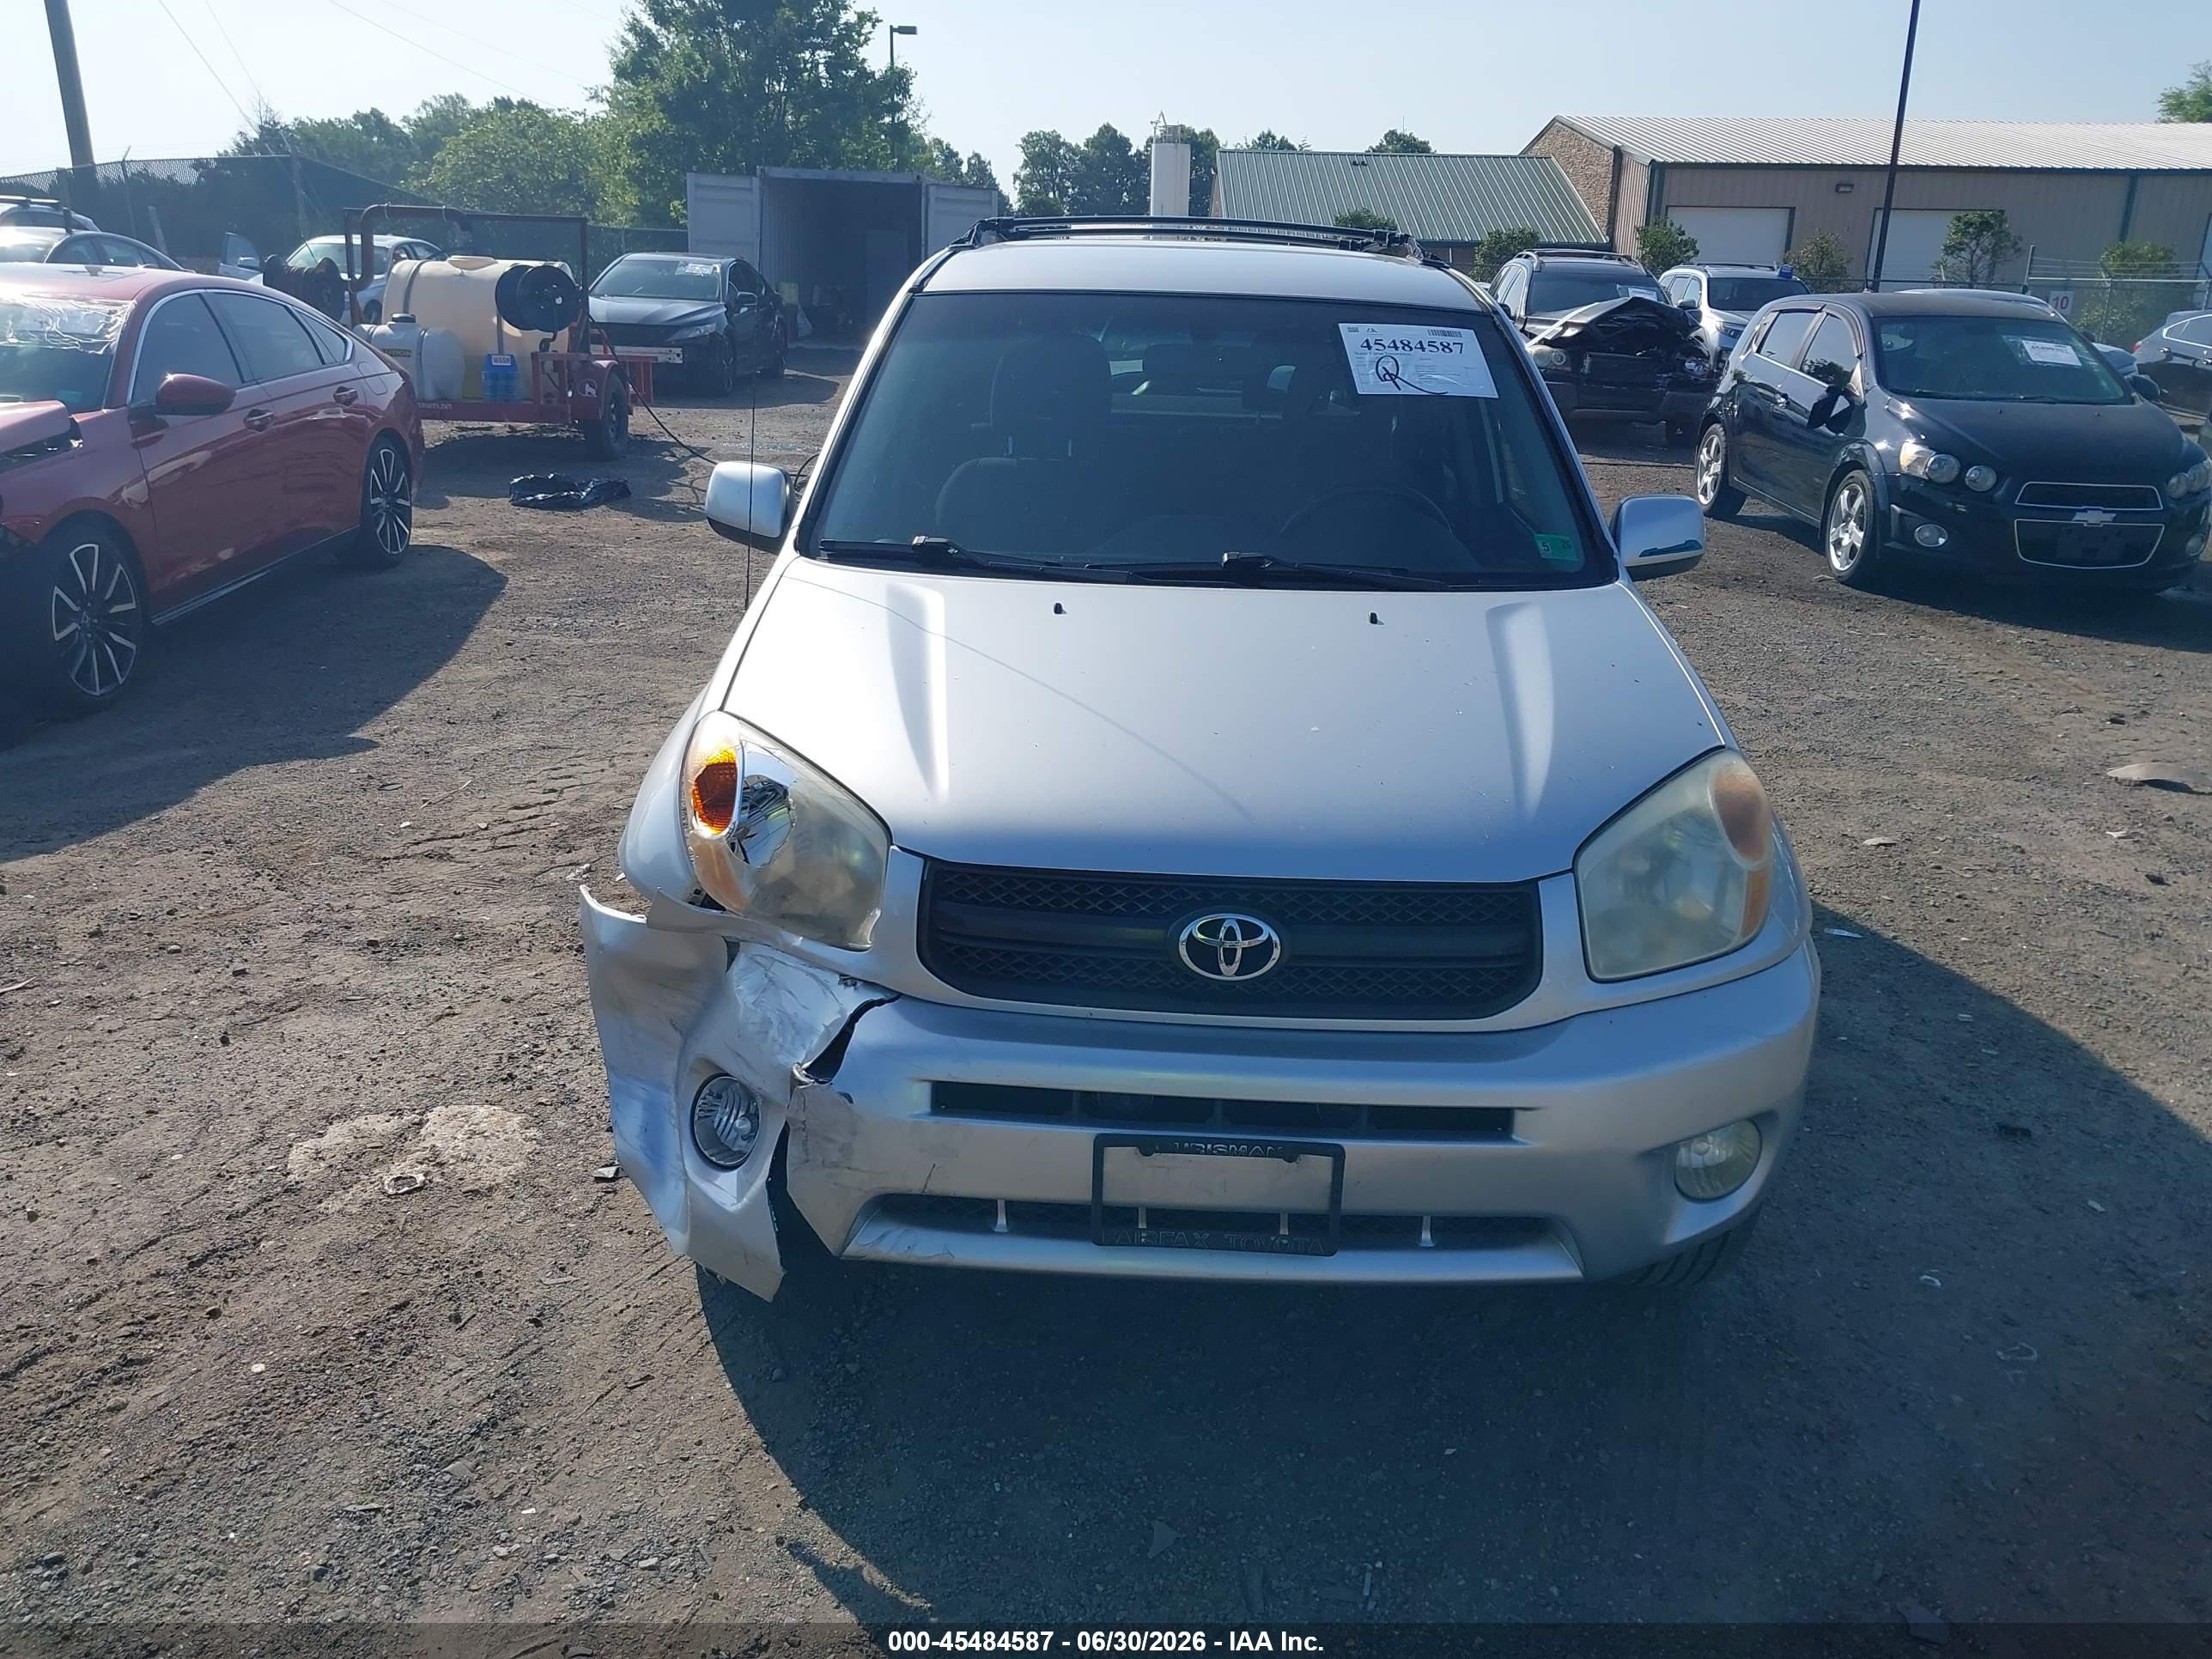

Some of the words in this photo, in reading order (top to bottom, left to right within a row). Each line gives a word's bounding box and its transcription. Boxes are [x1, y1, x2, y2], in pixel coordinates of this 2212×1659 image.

[2052, 295, 2069, 310] 10
[1360, 338, 1463, 354] 45484587
[1155, 1140, 1285, 1158] URISMAN
